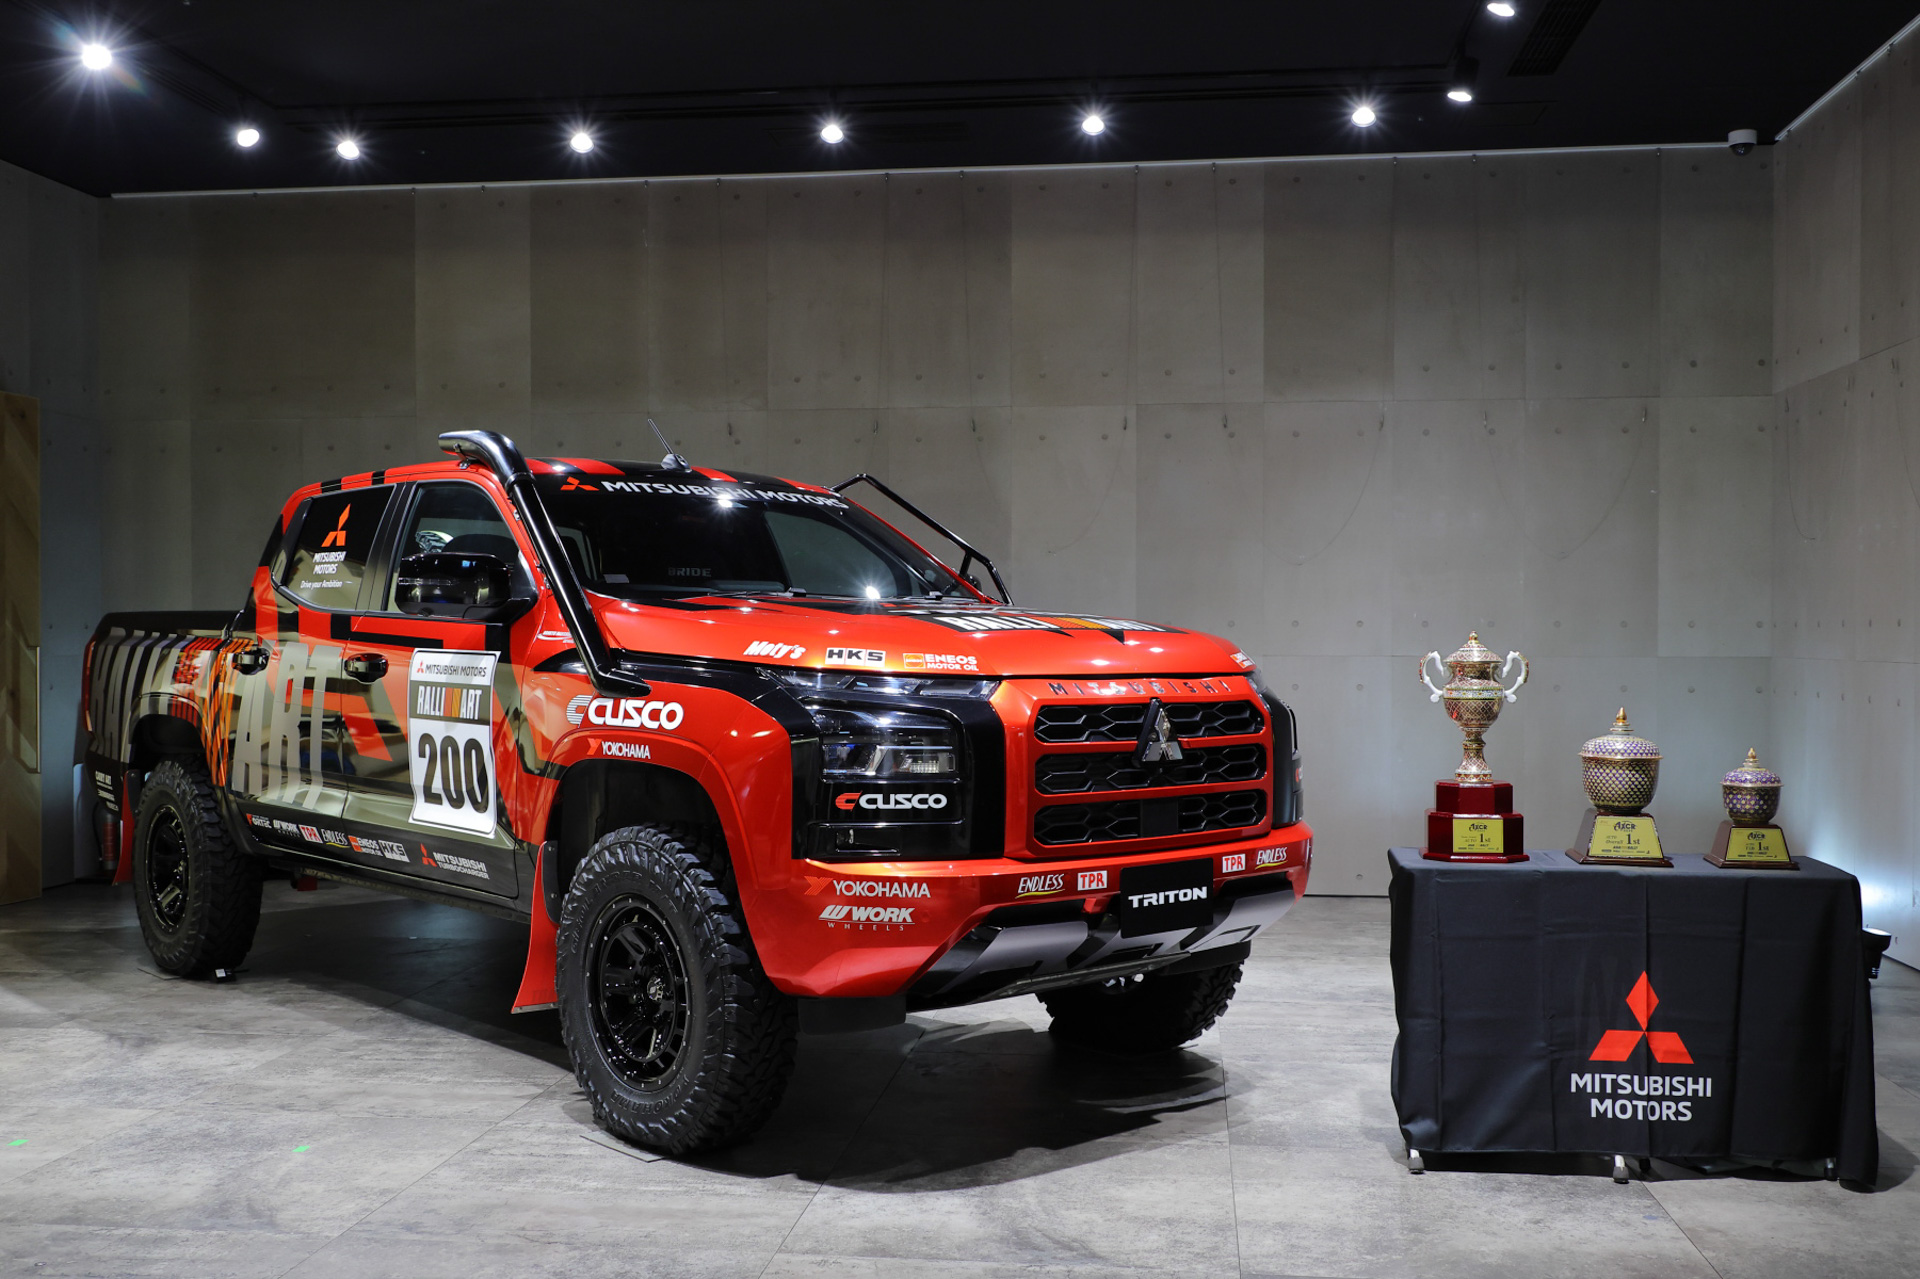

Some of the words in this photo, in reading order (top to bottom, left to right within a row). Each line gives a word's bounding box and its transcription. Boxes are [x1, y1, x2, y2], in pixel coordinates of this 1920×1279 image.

[601, 481, 758, 499] MITSUBISHI
[755, 490, 849, 509] MOTORS
[312, 551, 347, 563] MITSUBISHI
[312, 563, 338, 575] MOTORS
[667, 567, 712, 577] BRIDE
[743, 640, 806, 659] Moty's
[827, 649, 884, 662] HKS
[925, 653, 977, 665] ENEOS
[927, 662, 961, 670] MOTOR
[963, 664, 979, 672] OIL
[425, 663, 460, 676] MITSUBISHI
[461, 666, 487, 678] MOTORS
[1048, 679, 1231, 696] MITSUBISHI
[588, 697, 684, 731] CUSCO
[602, 741, 651, 759] YOKOHAMA
[418, 732, 490, 814] 200
[859, 793, 947, 810] CUSCO
[300, 826, 322, 842] TPR
[320, 828, 348, 846] ENDLESS
[1626, 833, 1640, 845] 1st
[379, 841, 407, 858] HKS
[1256, 847, 1287, 866] ENDLESS
[433, 851, 487, 873] MITSUBISHI
[1223, 855, 1244, 872] TPR
[832, 879, 931, 898] YOKOHAMA
[1018, 873, 1065, 894] ENDLESS
[1079, 872, 1105, 889] TPR
[1128, 886, 1208, 908] TRITON
[851, 906, 915, 923] WORK
[827, 922, 904, 931] WHEELS
[1570, 1072, 1712, 1098] MITSUBISHI
[1590, 1098, 1693, 1122] MOTORS
